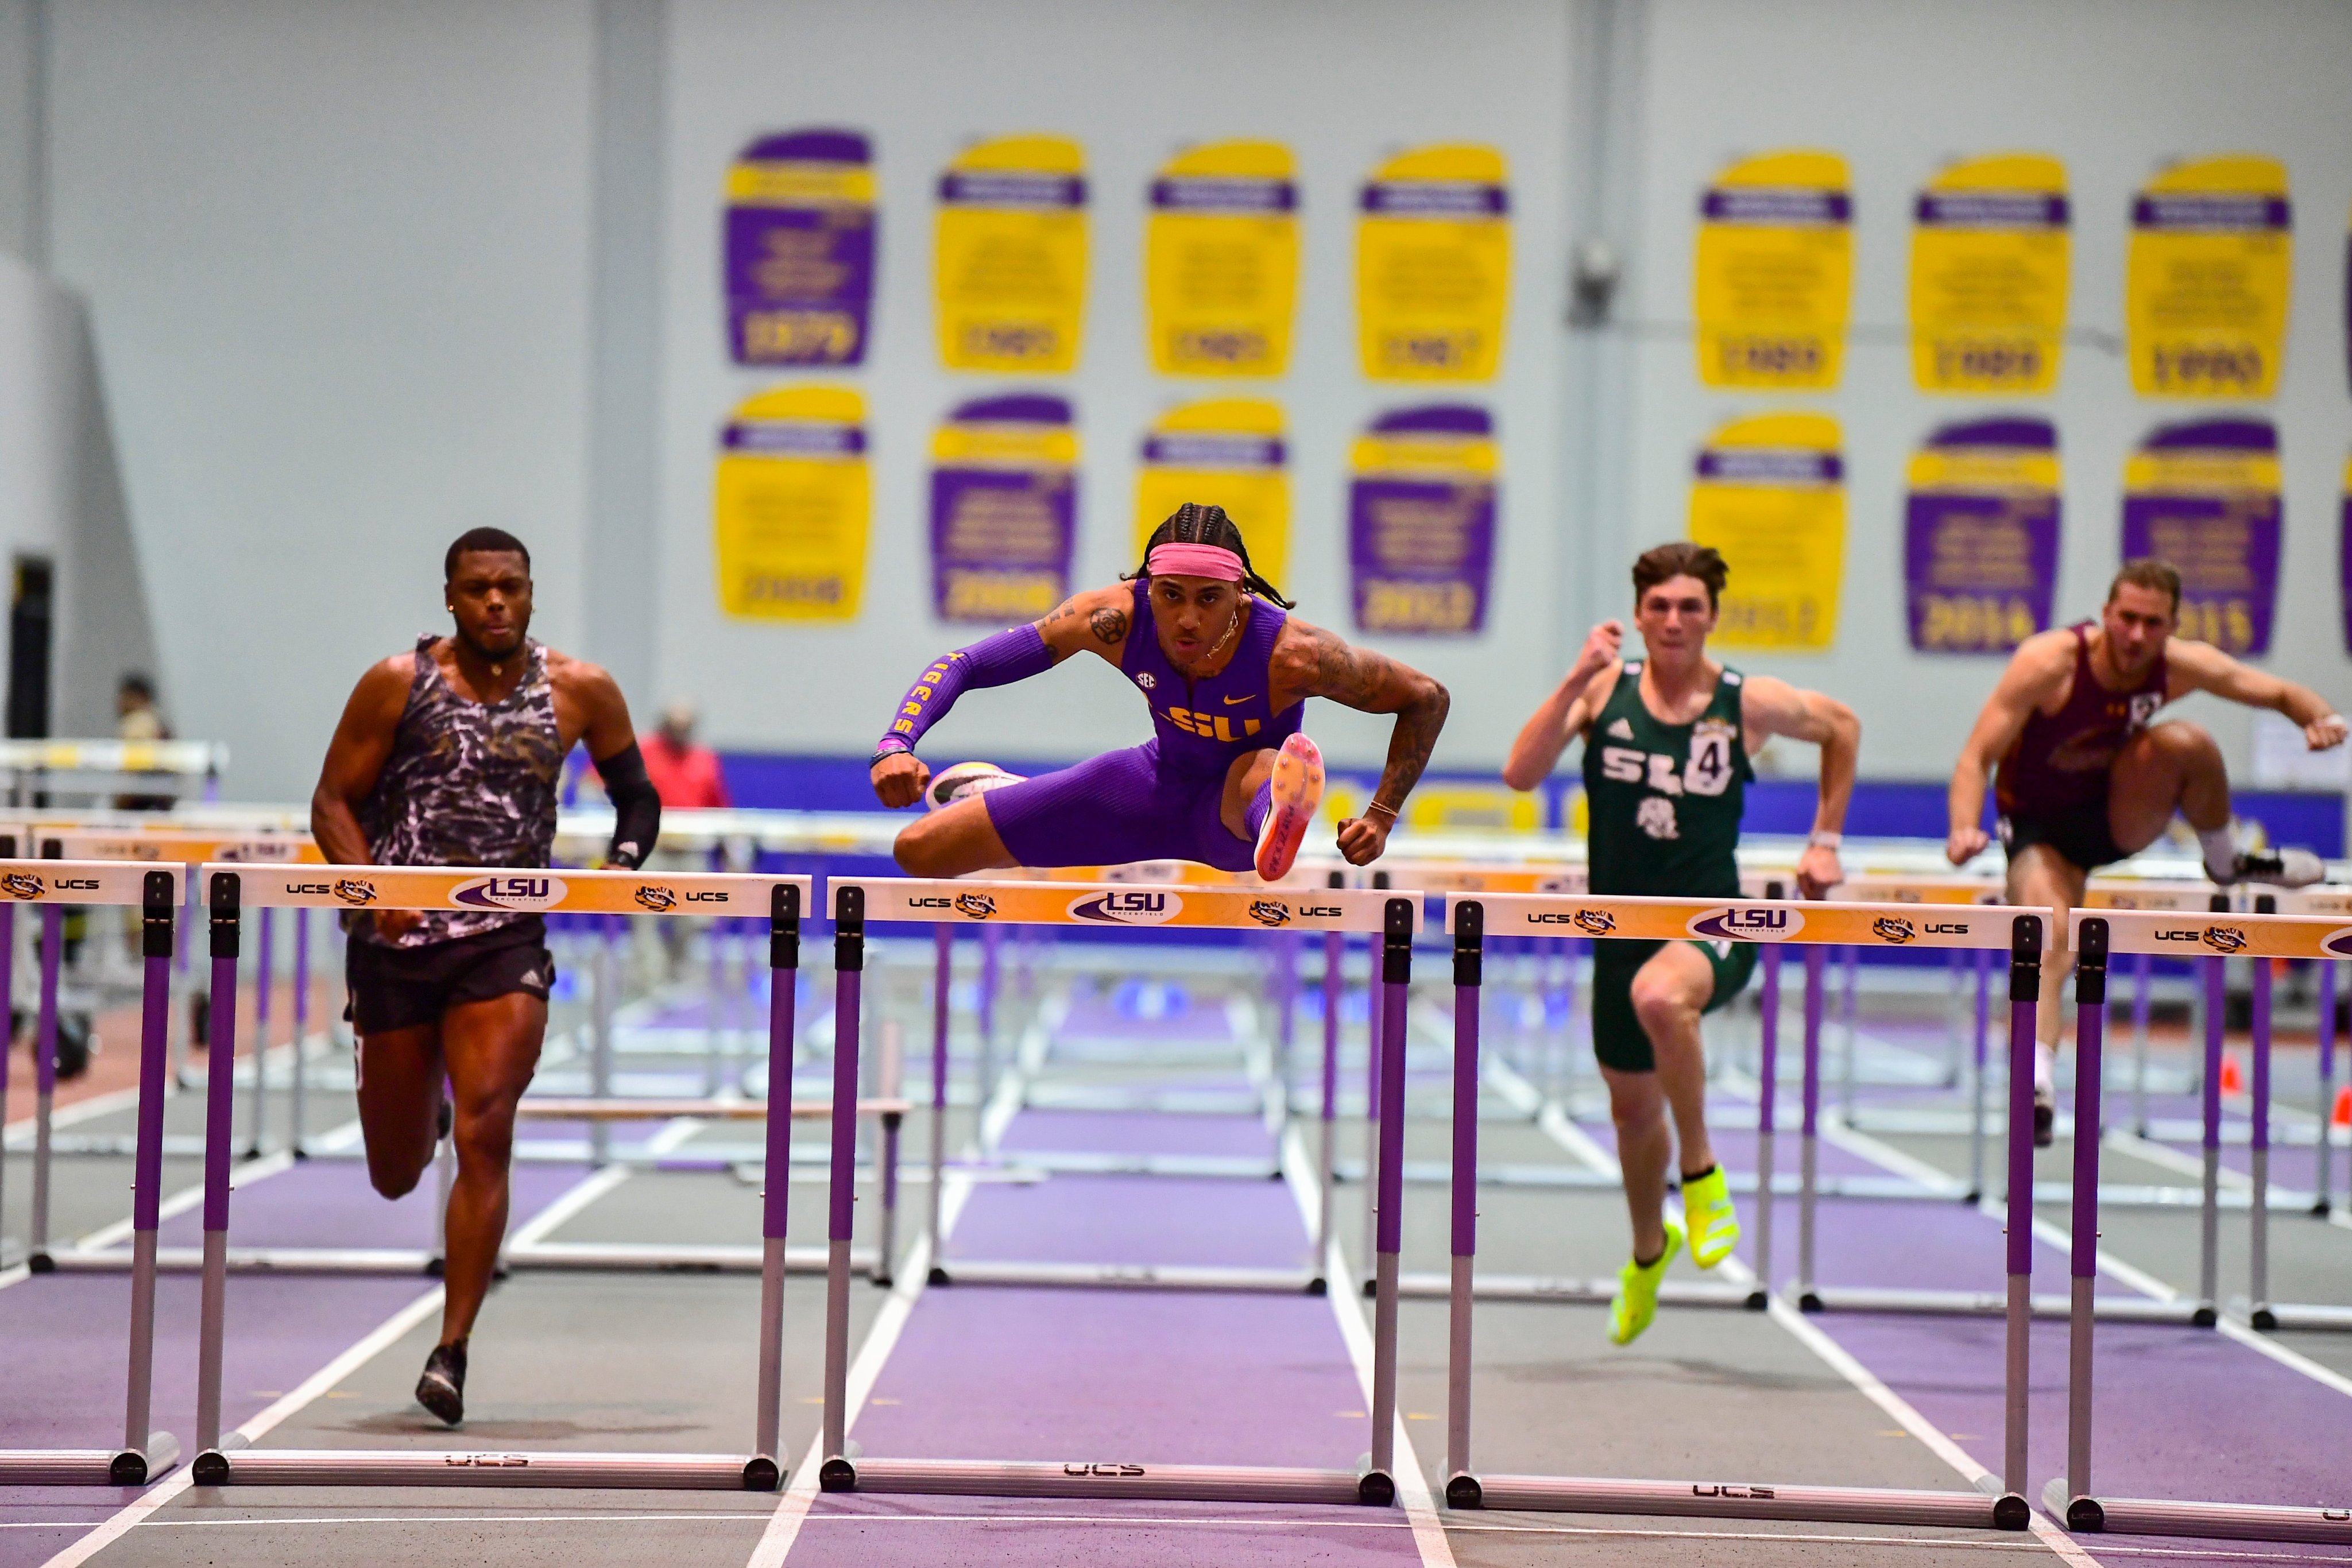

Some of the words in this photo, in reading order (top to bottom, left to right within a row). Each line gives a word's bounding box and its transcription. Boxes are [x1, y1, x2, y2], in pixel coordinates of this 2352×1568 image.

[744, 312, 858, 357] 1979
[2153, 341, 2264, 387] 1990
[1138, 673, 1155, 688] SEC
[894, 652, 965, 733] TIGERS
[1698, 741, 1723, 780] 4
[55, 879, 99, 890] UCS
[286, 884, 330, 894] UCS
[490, 878, 549, 897] LSU
[686, 892, 729, 902] UCS
[909, 897, 951, 908] UCS
[1107, 892, 1165, 911] LSU
[1299, 907, 1342, 917] UCS
[1527, 913, 1570, 924] UCS
[1728, 909, 1786, 928] LSU
[1924, 924, 1968, 934] UCS
[2154, 931, 2199, 941] UCS
[446, 1454, 528, 1467] UCS
[1064, 1464, 1145, 1476] UCS
[1693, 1485, 1775, 1499] UCS
